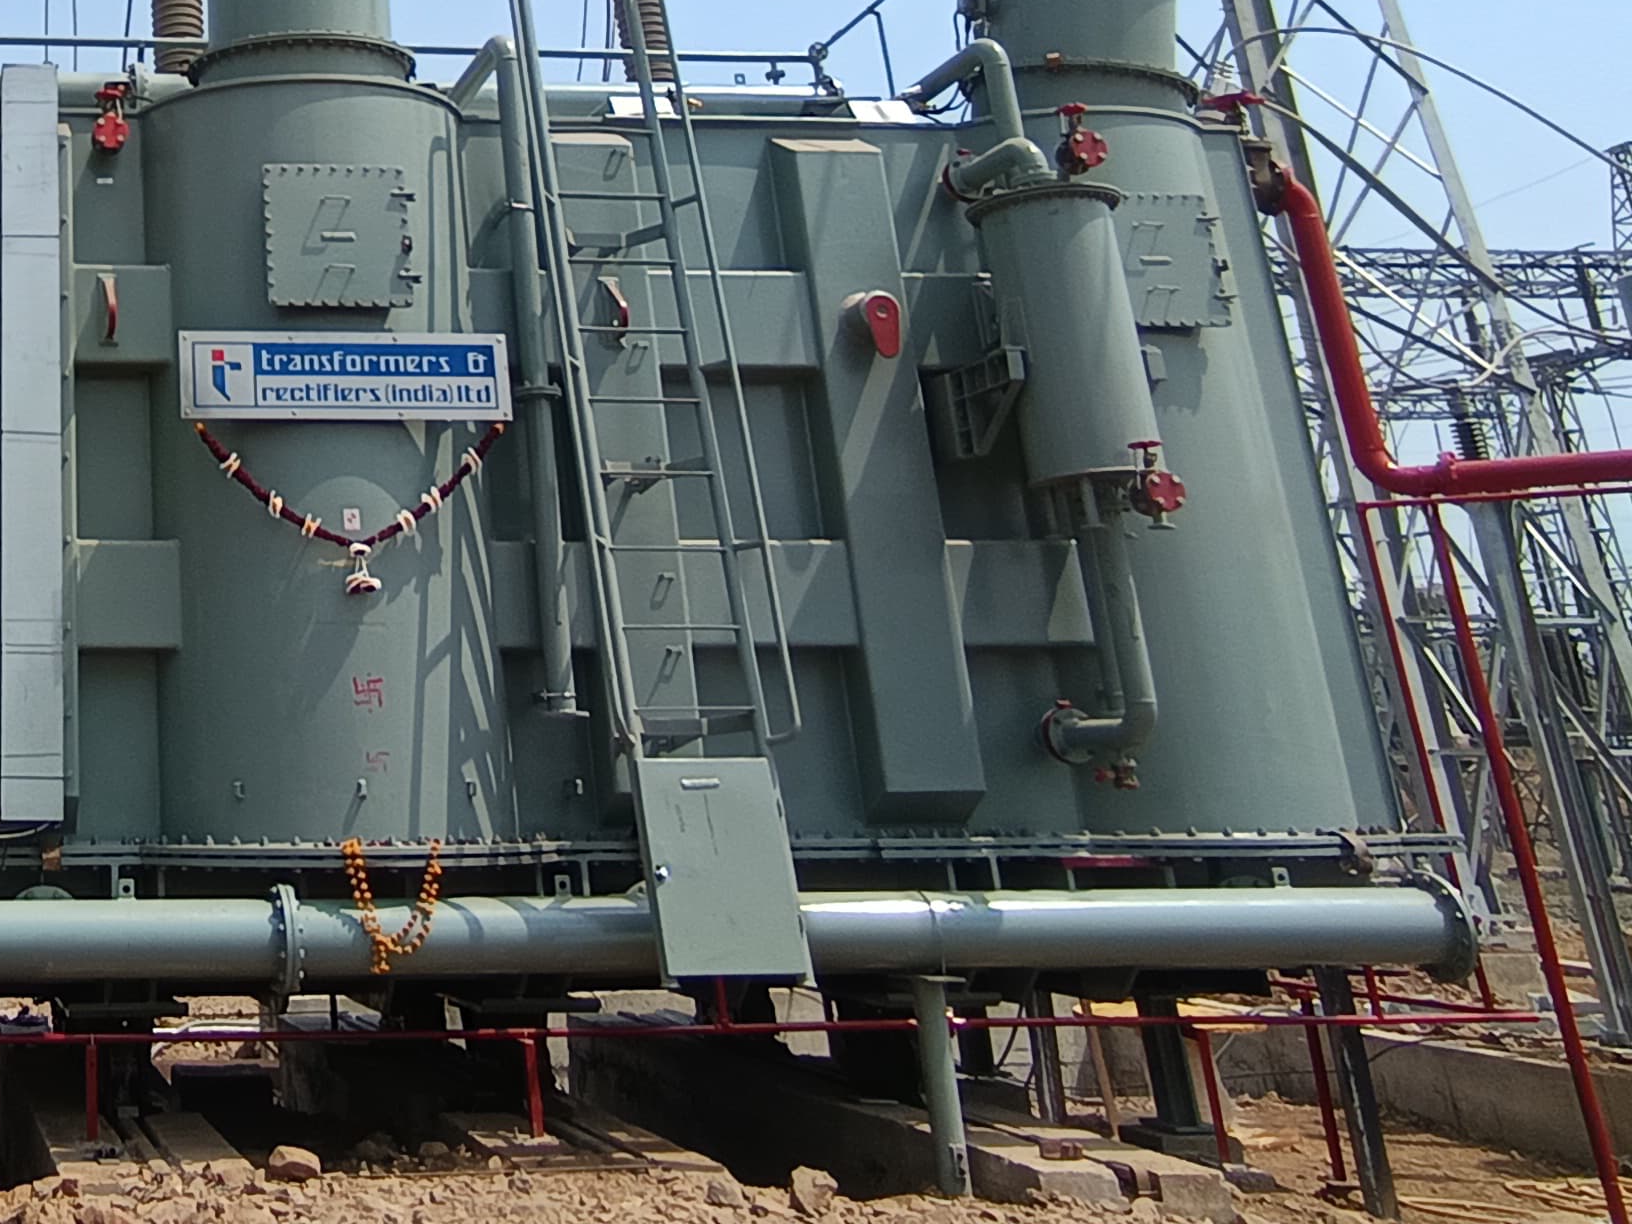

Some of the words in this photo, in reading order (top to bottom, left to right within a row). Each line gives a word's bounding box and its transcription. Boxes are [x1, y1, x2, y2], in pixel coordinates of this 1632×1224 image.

[261, 350, 451, 373] transformers
[467, 352, 488, 373] &
[262, 384, 381, 402] rectifiers
[457, 384, 491, 403] ltd
